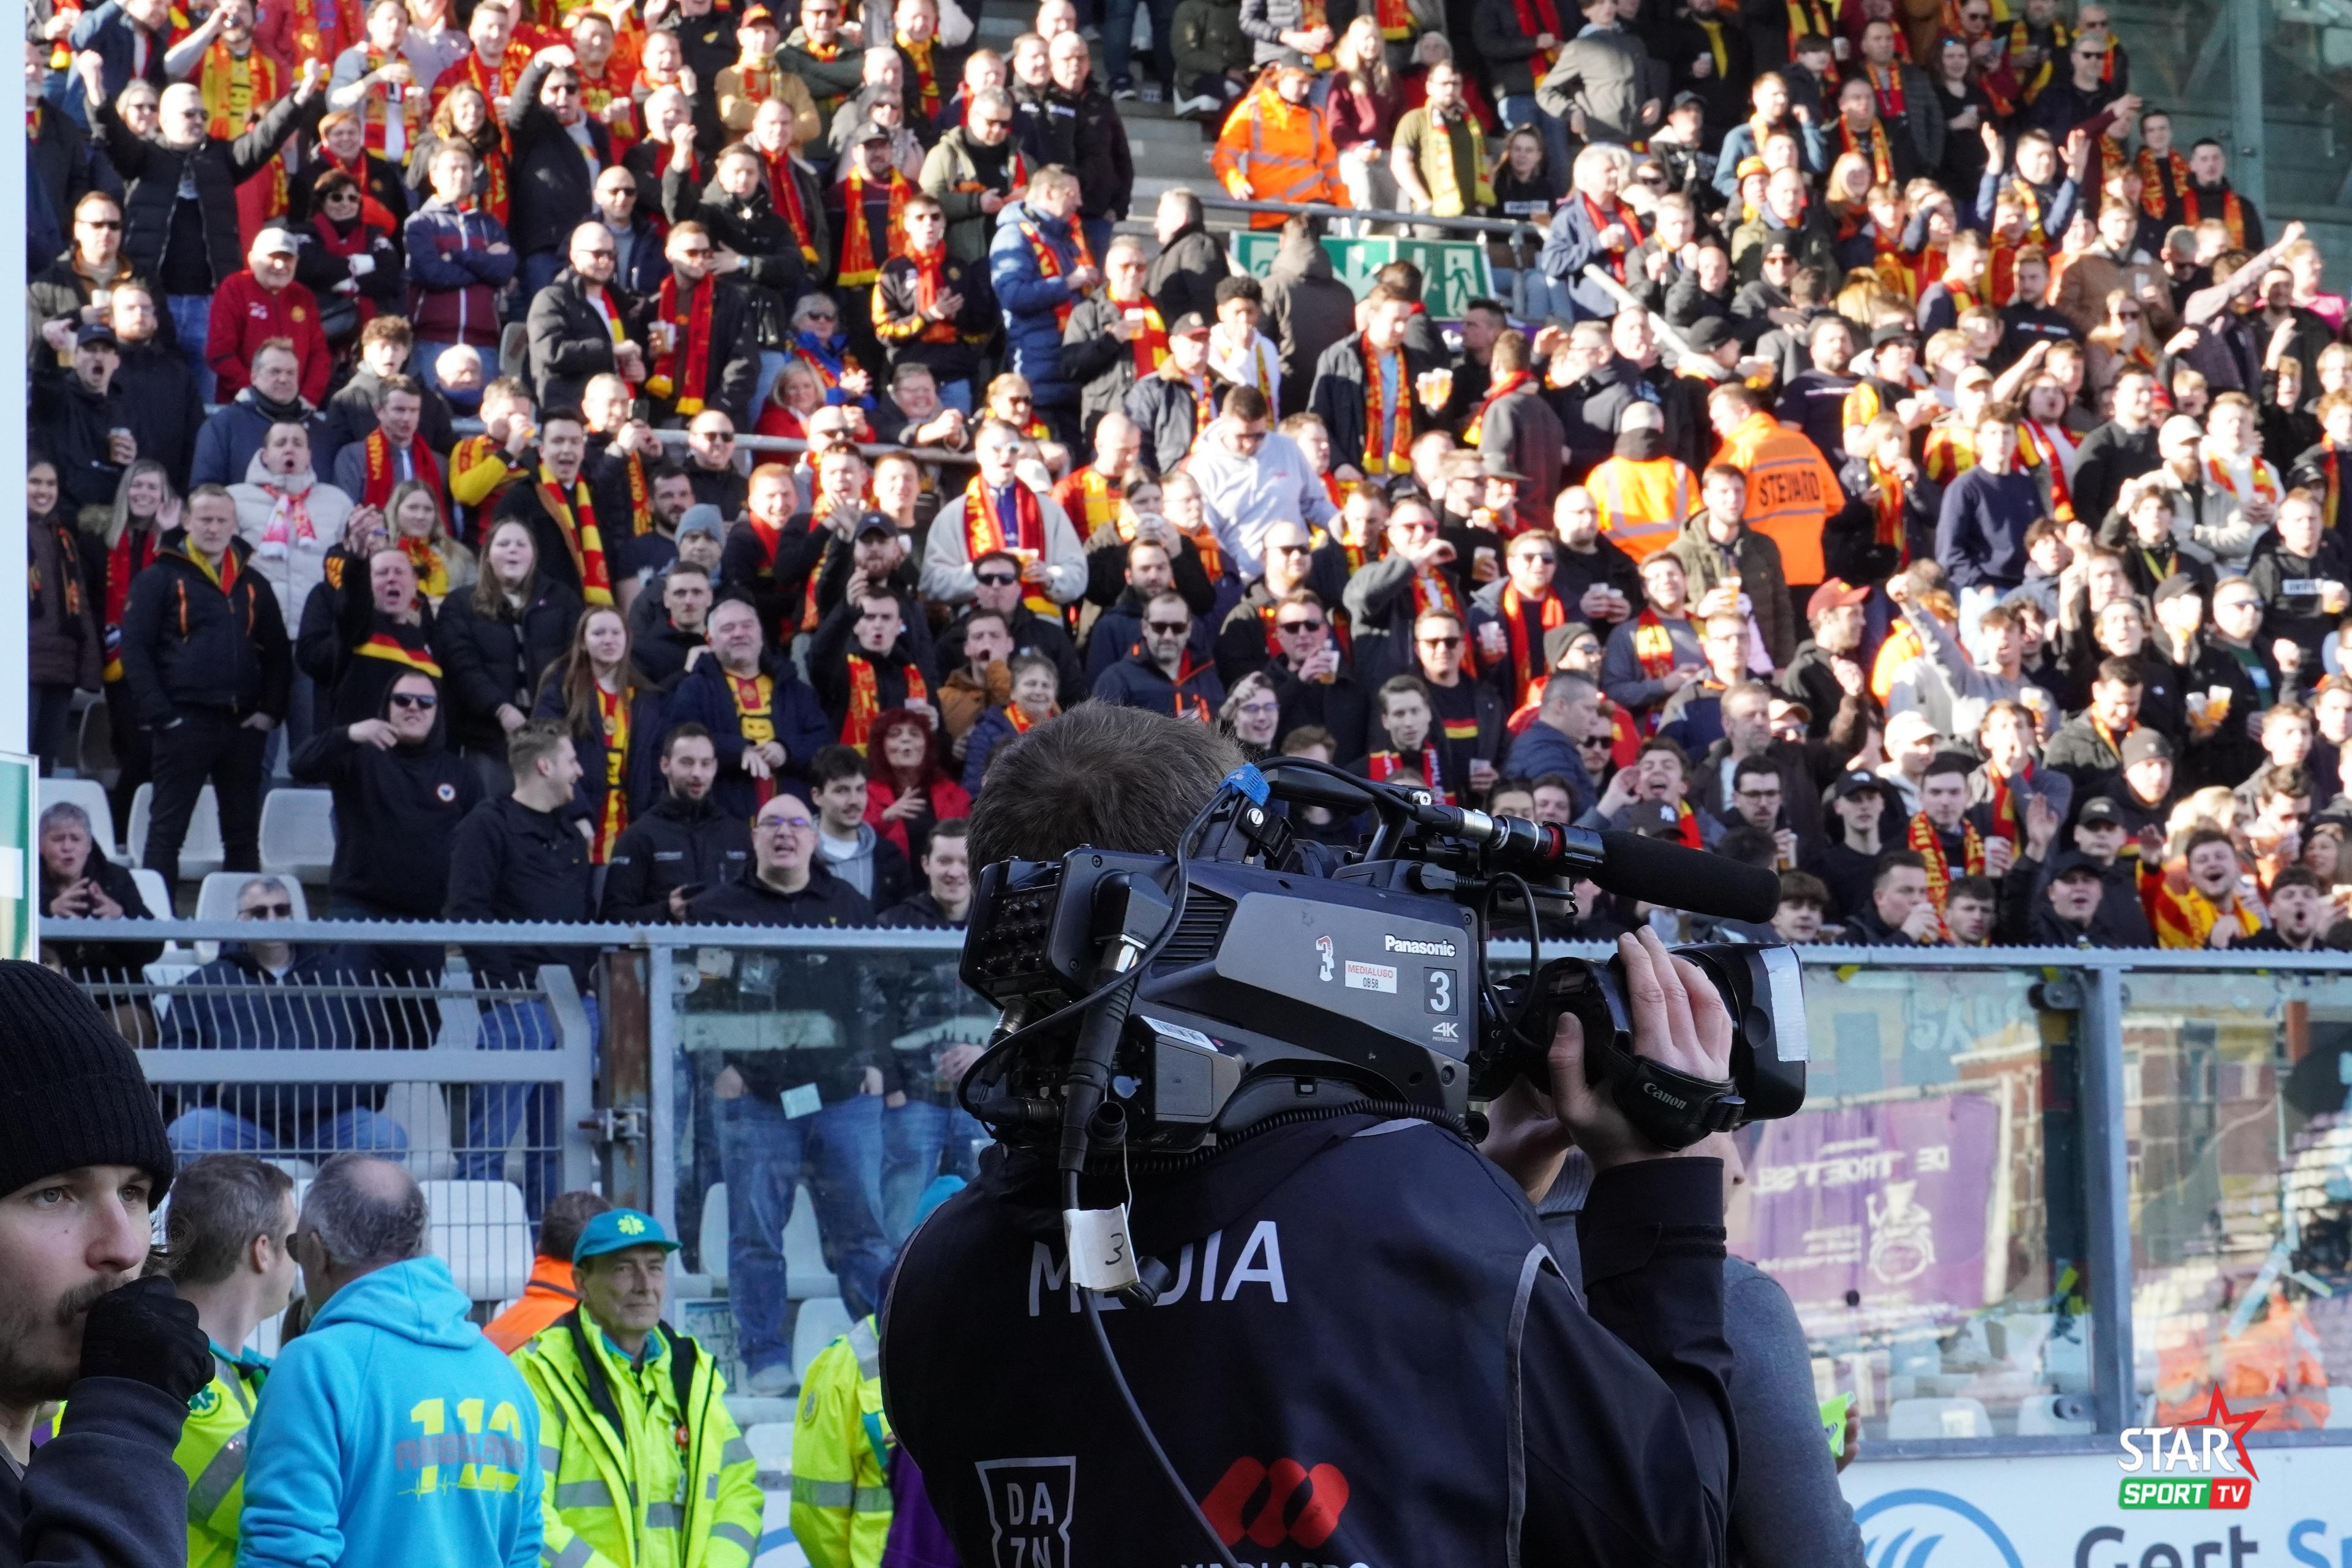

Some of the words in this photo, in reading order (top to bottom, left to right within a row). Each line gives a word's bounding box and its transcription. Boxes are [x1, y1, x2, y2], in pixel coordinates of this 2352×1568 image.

[1385, 934, 1457, 957] Panasonic
[1348, 964, 1393, 979] MEDIALUSO
[1430, 971, 1450, 1012] 3
[1433, 1022, 1459, 1038] 4K
[1643, 1082, 1687, 1110] Canon
[1105, 1232, 1125, 1265] 3
